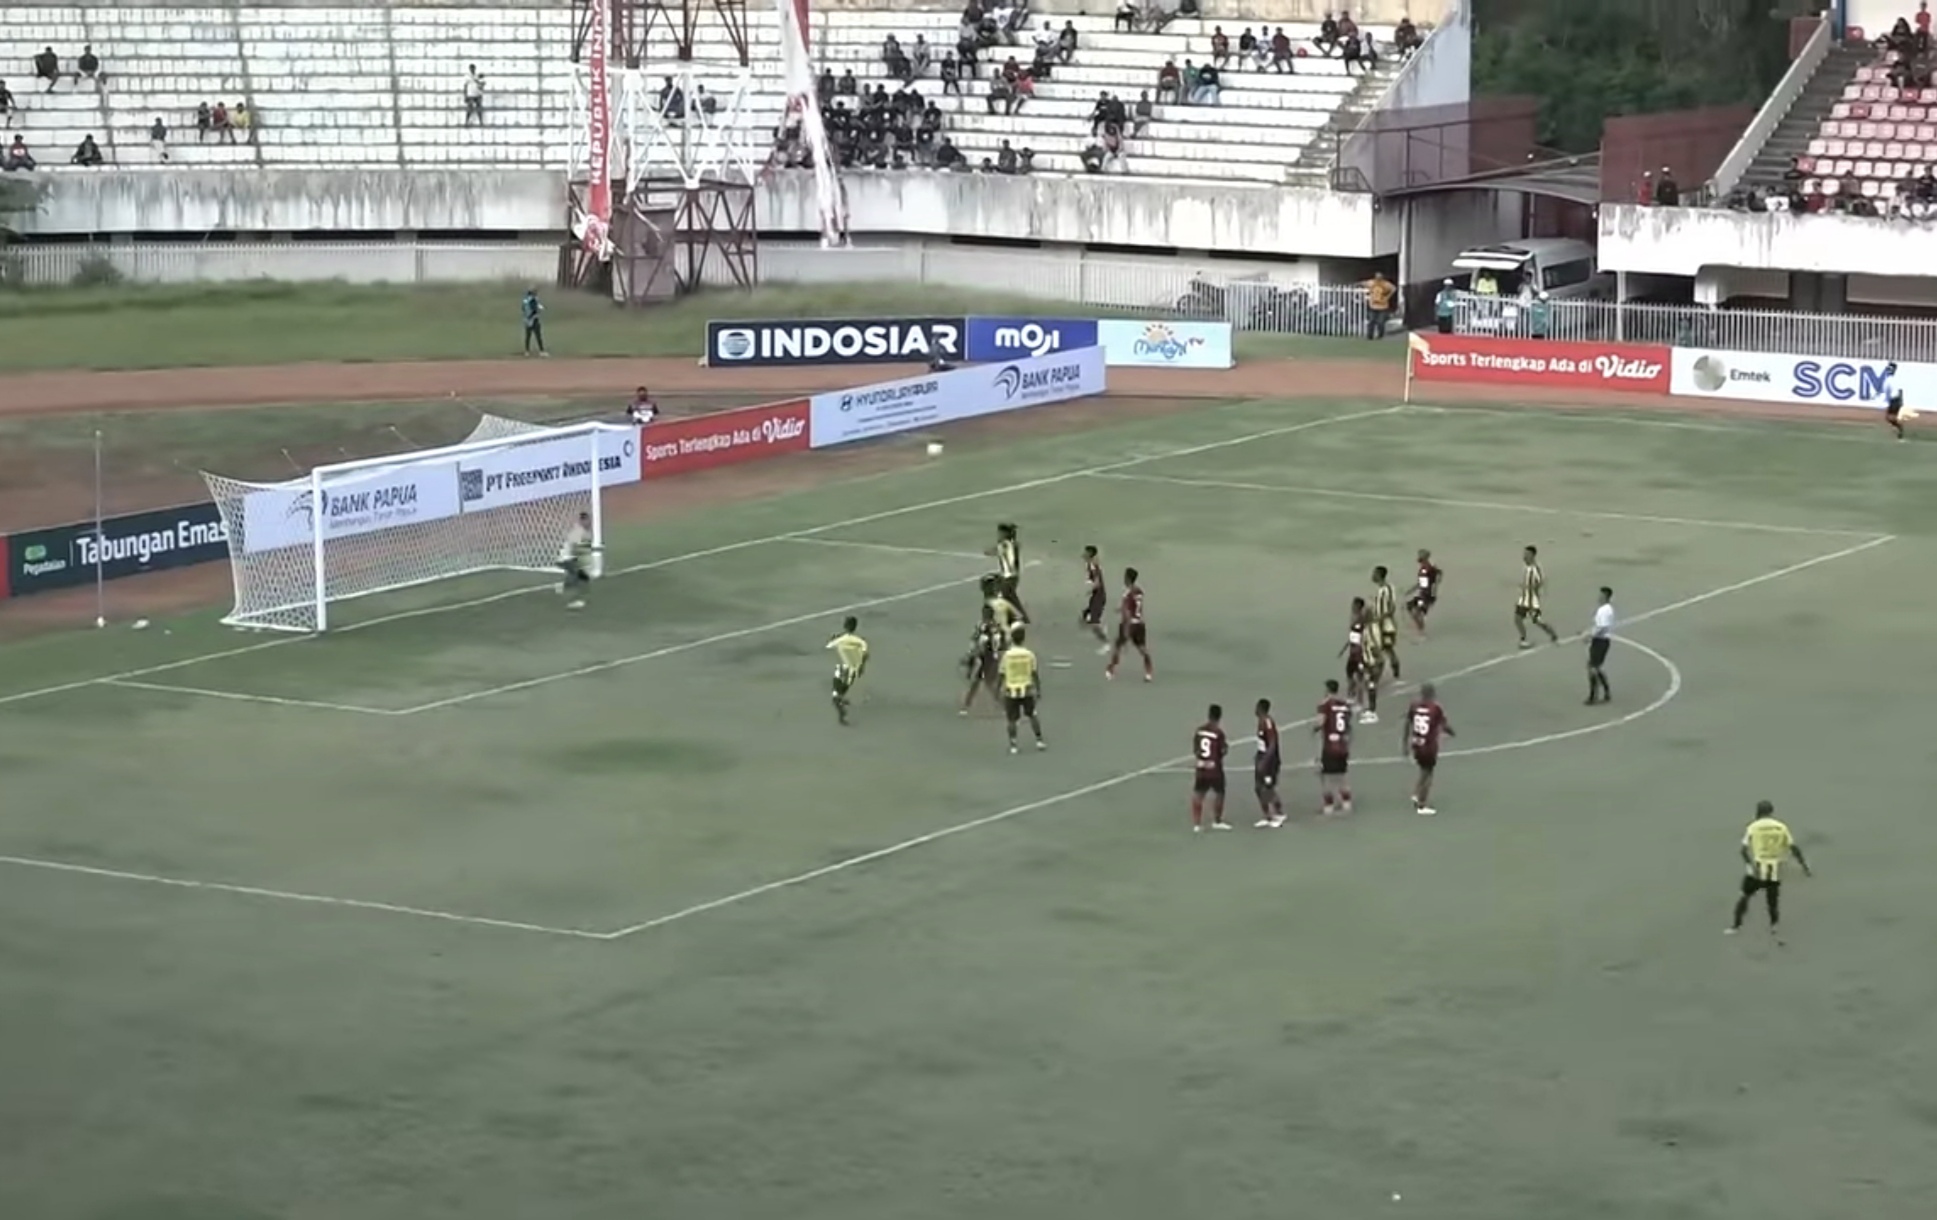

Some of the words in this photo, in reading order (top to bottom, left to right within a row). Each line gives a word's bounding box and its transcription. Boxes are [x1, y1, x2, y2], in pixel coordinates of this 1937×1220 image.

[591, 68, 605, 185] REPUBLIK
[761, 325, 958, 358] INDOSIAR
[1022, 368, 1049, 389] BANK
[1050, 363, 1080, 383] PAPUA
[1422, 351, 1466, 367] Sports
[1469, 353, 1546, 372] Terlengkap
[1550, 358, 1575, 373] Ada
[1579, 359, 1593, 373] di
[1595, 354, 1662, 379] Vidio
[1730, 368, 1771, 383] Emtek
[1792, 360, 1888, 401] SCM
[645, 444, 678, 461] Sports
[733, 429, 751, 444] Ada
[762, 416, 805, 443] Vidio
[486, 473, 504, 493] PT
[562, 454, 622, 478] INDOESIA
[330, 491, 371, 517] BANK
[373, 483, 418, 510] PAPUA
[76, 528, 174, 565] Tabungan
[177, 520, 229, 549] Emas
[1200, 738, 1212, 758] 9
